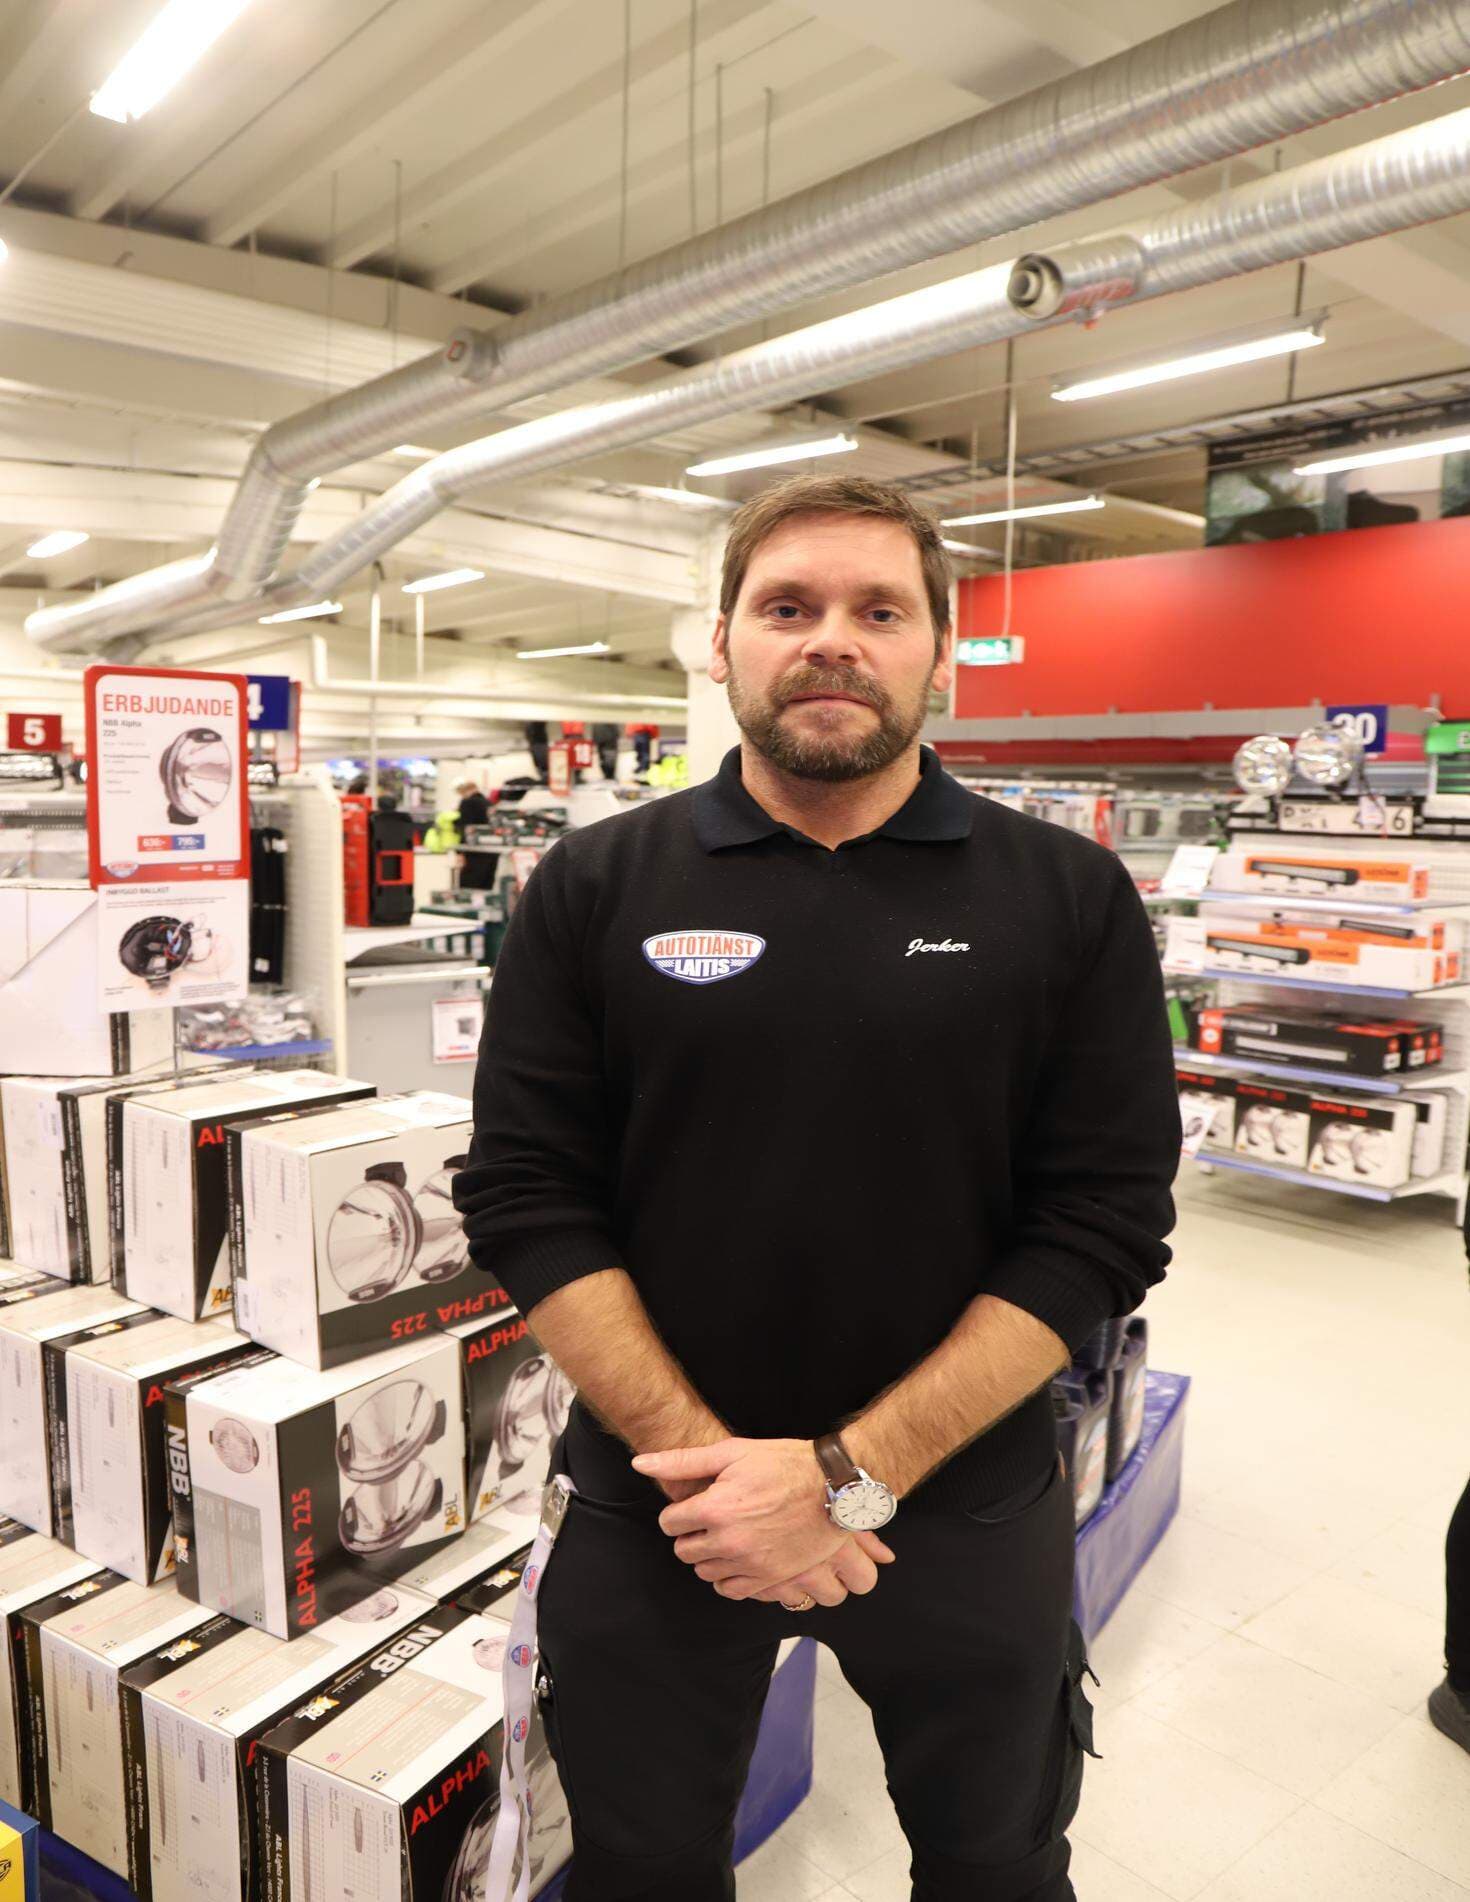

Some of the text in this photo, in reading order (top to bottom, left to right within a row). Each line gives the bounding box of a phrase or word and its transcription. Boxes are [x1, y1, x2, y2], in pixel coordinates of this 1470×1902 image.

[102, 694, 234, 717] ERBJUDANDE
[23, 718, 46, 746] 5
[654, 933, 755, 956] AUTOTJÄNST
[904, 938, 970, 957] Jerker
[674, 958, 730, 977] LAITIS
[391, 1312, 428, 1340] 225
[466, 1319, 530, 1364] ALPHA
[167, 1424, 191, 1497] NBB
[291, 1487, 318, 1626] ALPHA 225
[370, 1624, 444, 1674] NBB
[410, 1750, 492, 1836] ALPHA
[274, 1853, 283, 1878] Lights
